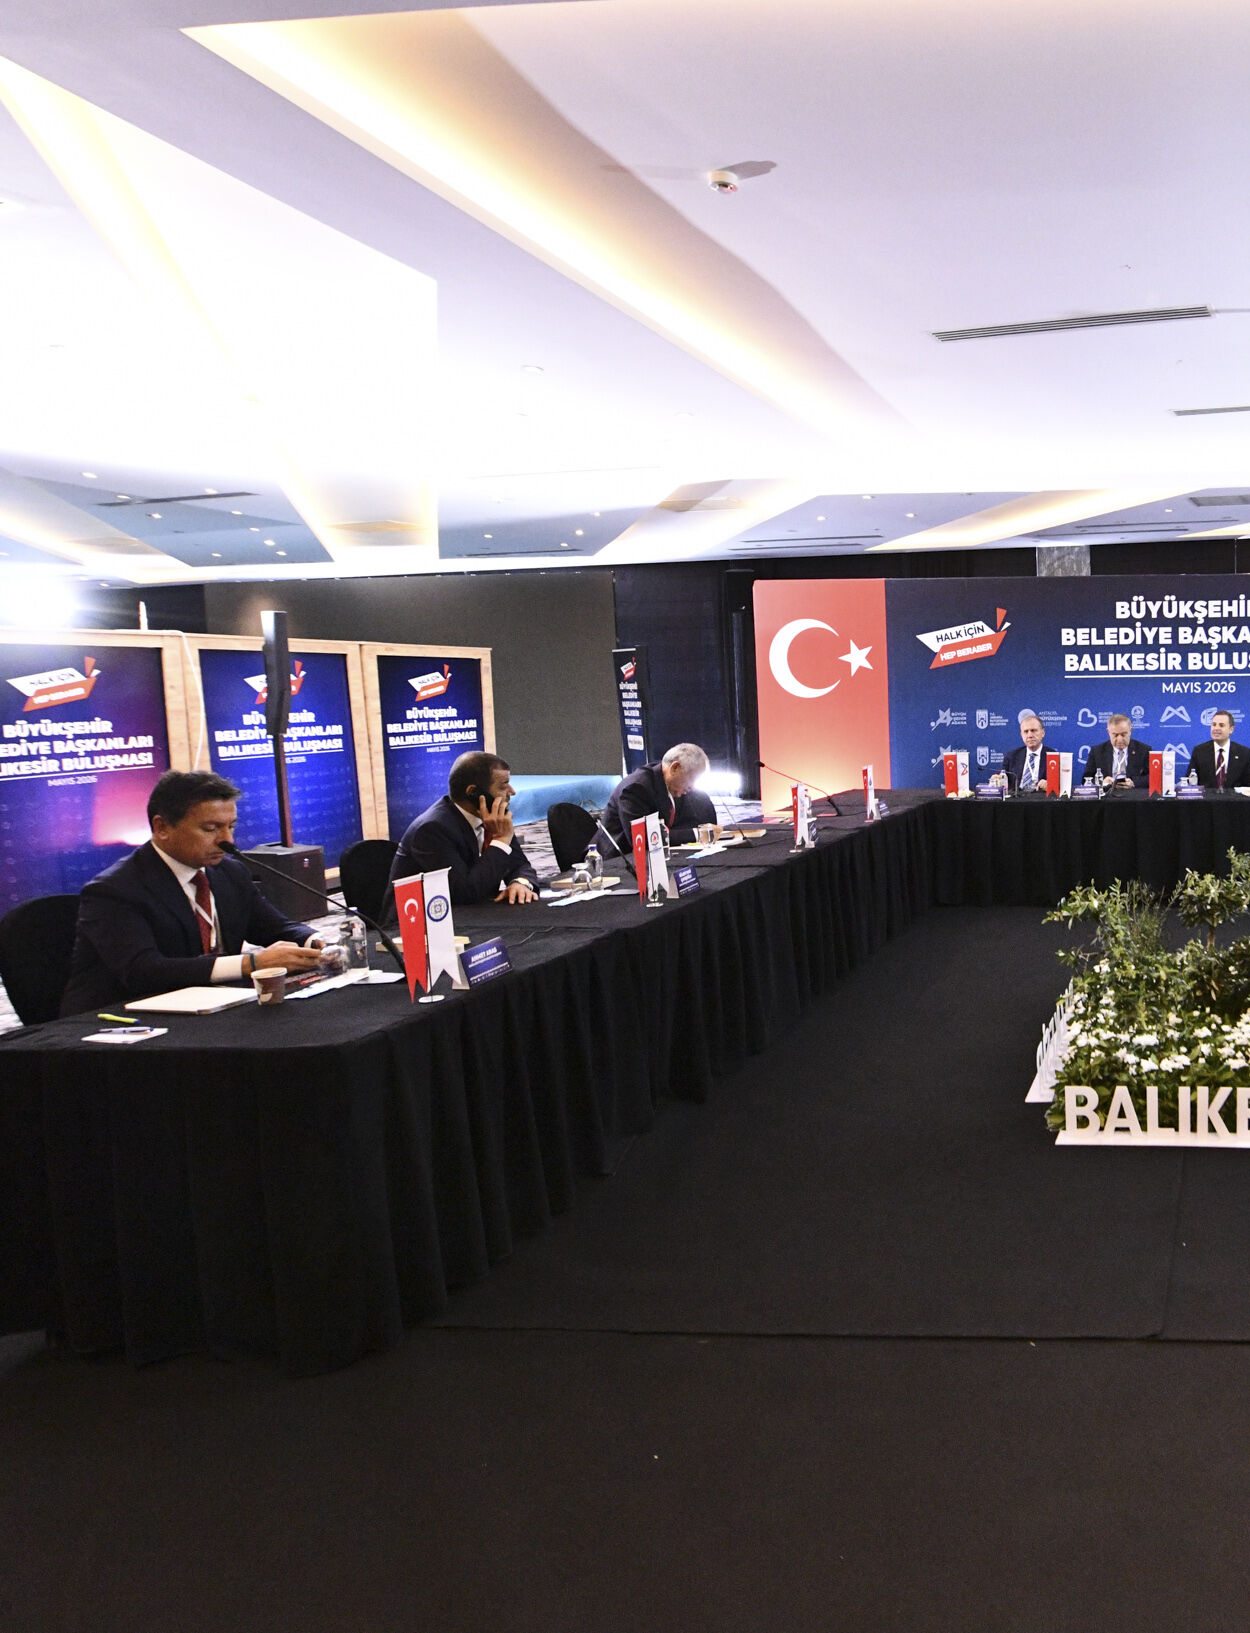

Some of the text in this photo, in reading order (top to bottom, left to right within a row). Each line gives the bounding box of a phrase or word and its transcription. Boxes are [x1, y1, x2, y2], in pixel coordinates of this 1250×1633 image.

[936, 623, 985, 643] HALK İÇİN
[1061, 621, 1173, 646] BELEDİYE
[940, 642, 993, 661] HEP BERABER
[1064, 647, 1182, 672] BALIKESİR
[1161, 681, 1237, 694] MAYIS 2026
[242, 709, 316, 725] BÜYEHİR
[406, 705, 458, 720] BÜYÜKŞEHİR
[2, 716, 114, 739] BÜYÜKŞEHİR
[214, 724, 343, 742] BELEDİY AŞKANLARI
[386, 719, 477, 733] BELEDİYE BAŞKANLARI
[0, 735, 155, 758] EDİYE BAŞKANLARI
[388, 731, 477, 746] BALIKESİR BULUŞMASI
[218, 739, 274, 757] BALIKESİ
[0, 752, 154, 777] IKESİR BULUŞMASI
